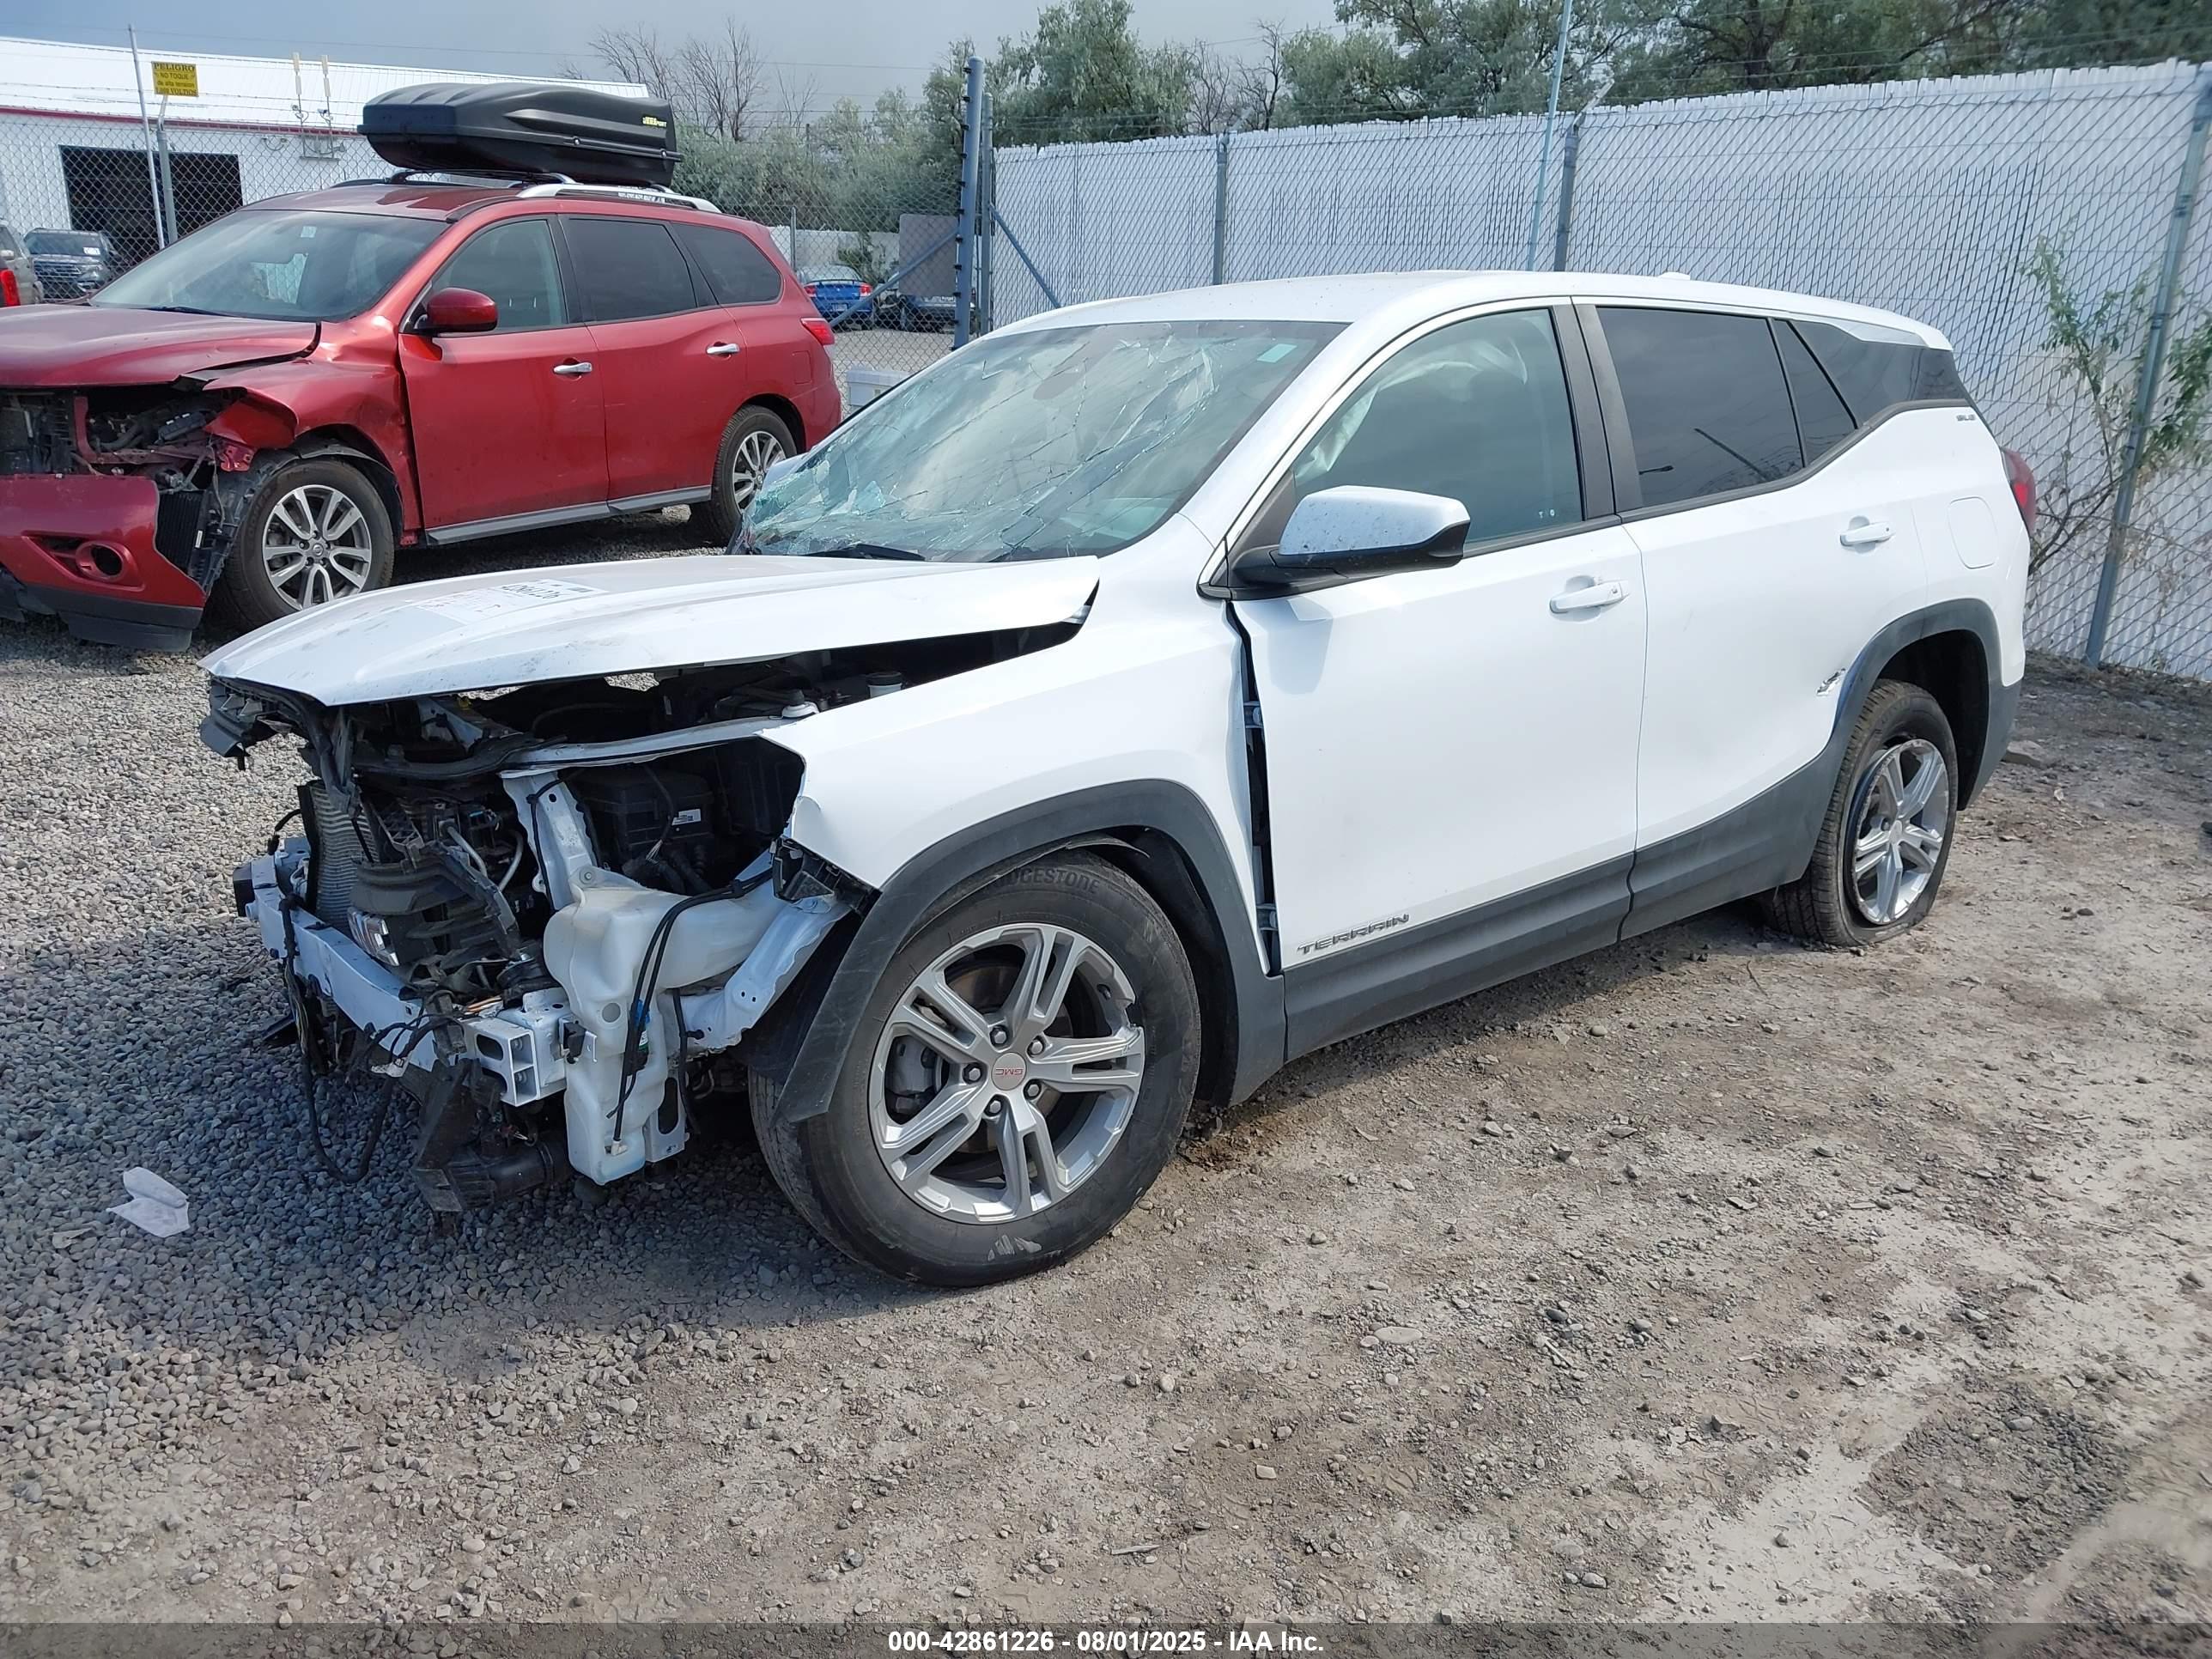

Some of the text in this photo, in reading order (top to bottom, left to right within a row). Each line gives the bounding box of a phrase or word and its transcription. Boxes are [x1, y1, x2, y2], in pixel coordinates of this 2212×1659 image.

[154, 63, 196, 71] PELIGRO
[1297, 913, 1410, 955] TERRAIN
[995, 1067, 1024, 1076] GMC
